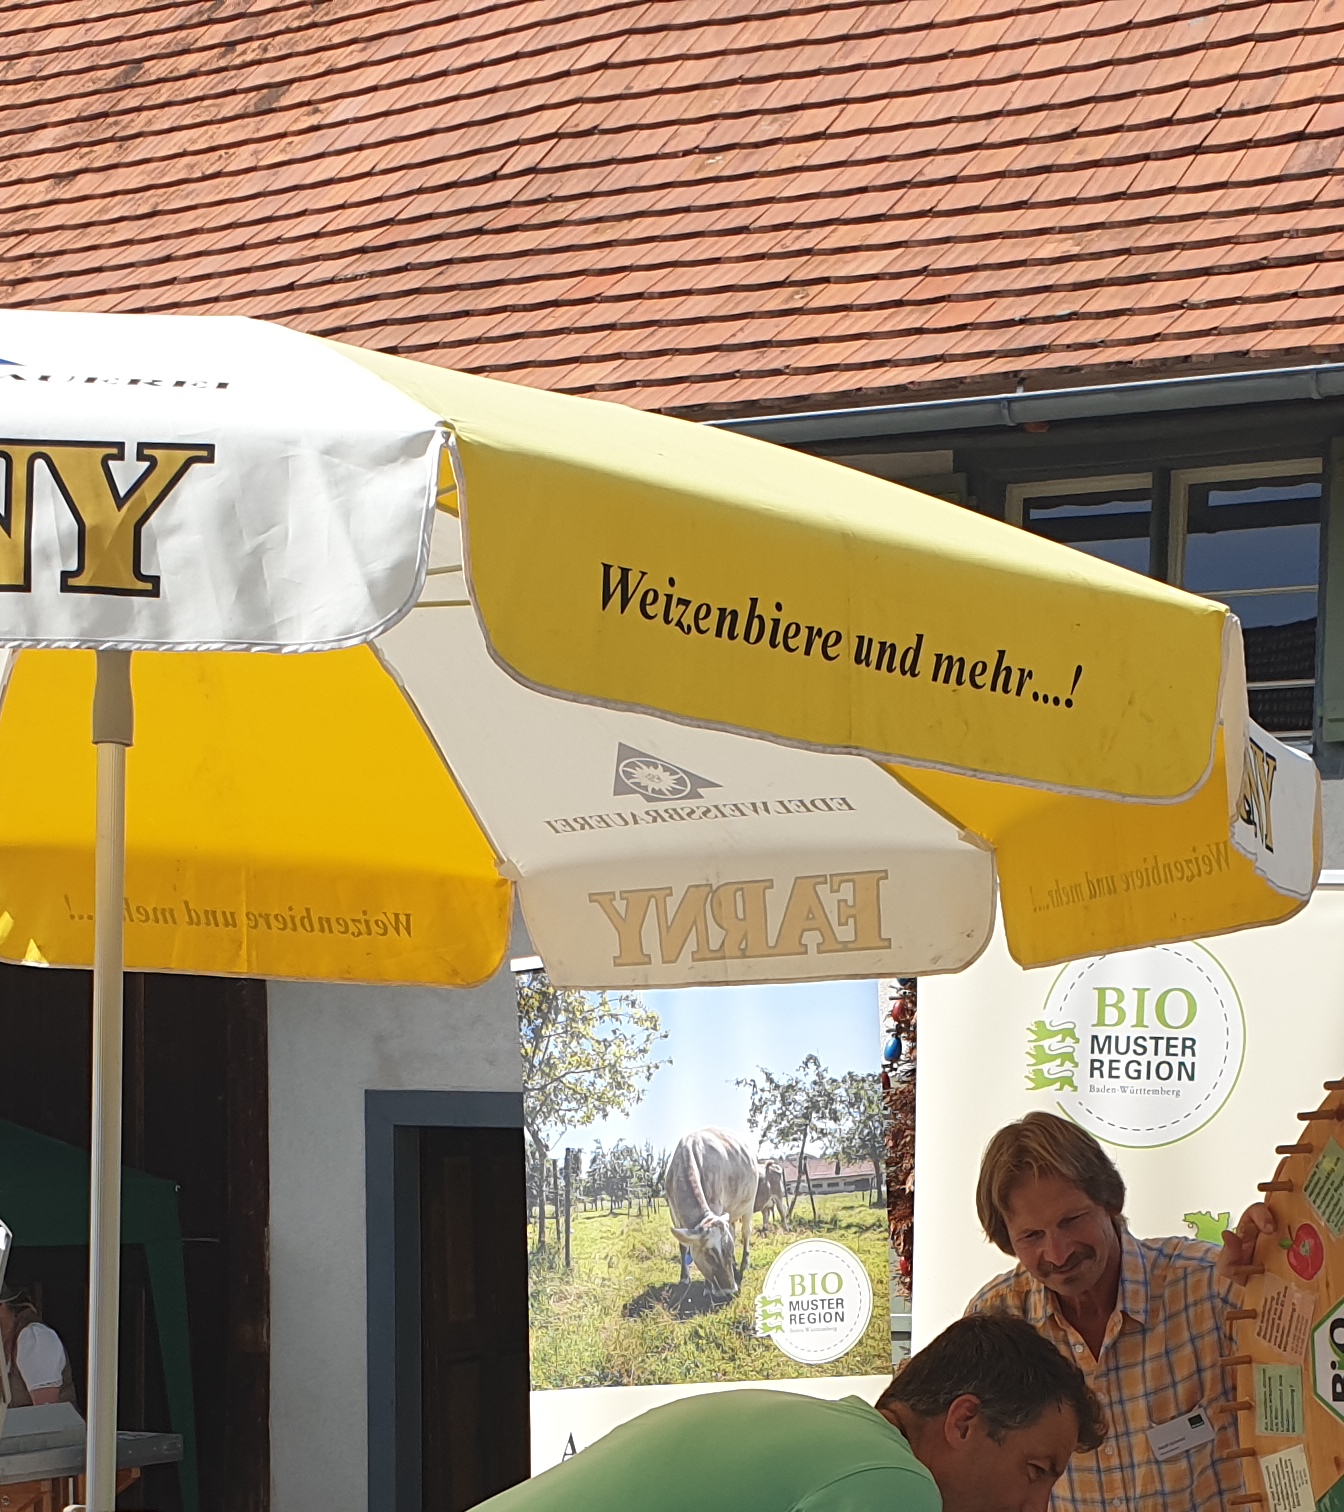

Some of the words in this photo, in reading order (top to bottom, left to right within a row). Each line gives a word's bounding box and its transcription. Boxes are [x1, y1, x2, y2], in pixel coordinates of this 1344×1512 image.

[600, 561, 843, 662] Weizenbiere
[853, 632, 926, 679] und
[931, 648, 1083, 709] mehr...!
[1091, 986, 1198, 1030] BIO
[1090, 1034, 1197, 1058] MUSTER
[1089, 1058, 1196, 1081] REGION
[1088, 1084, 1181, 1098] Baden-Württemberg
[788, 1271, 844, 1298] BIO
[789, 1297, 845, 1312] MUSTER
[789, 1310, 845, 1325] REGION
